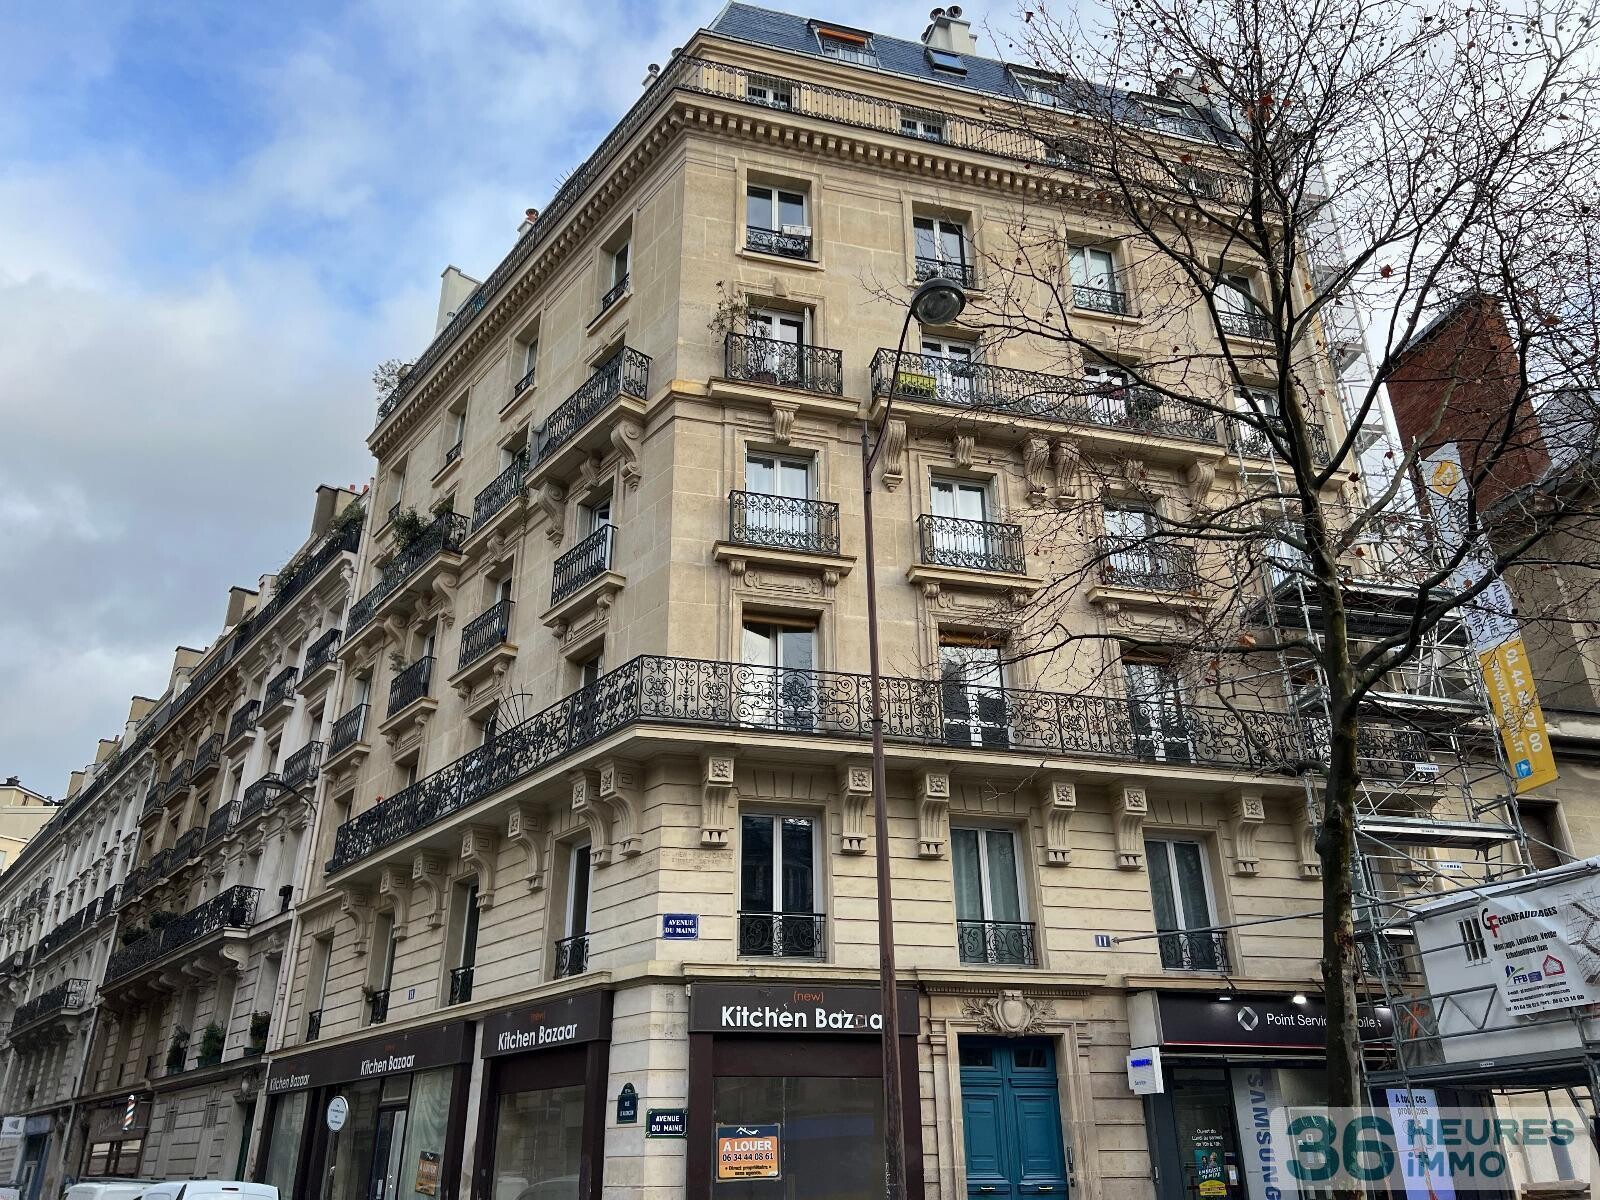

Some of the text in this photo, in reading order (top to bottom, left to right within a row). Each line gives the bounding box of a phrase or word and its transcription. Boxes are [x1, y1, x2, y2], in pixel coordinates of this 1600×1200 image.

[1528, 732, 1543, 753] 00
[1097, 935, 1107, 947] 11
[1513, 975, 1529, 984] FFB
[793, 991, 824, 1004] (new)
[721, 1005, 807, 1028] Kitchen
[1266, 1013, 1295, 1026] Point
[498, 1023, 578, 1051] Kitchen Bazaar
[360, 1054, 416, 1076] Kitchen Bazaar
[270, 1073, 311, 1091] Kitchen Bazaar
[651, 1124, 683, 1132] DU MAINE
[1247, 1072, 1281, 1200] SAMSUNG
[723, 1140, 773, 1152] A LOUER
[722, 1152, 774, 1162] 06 34 44 08 61
